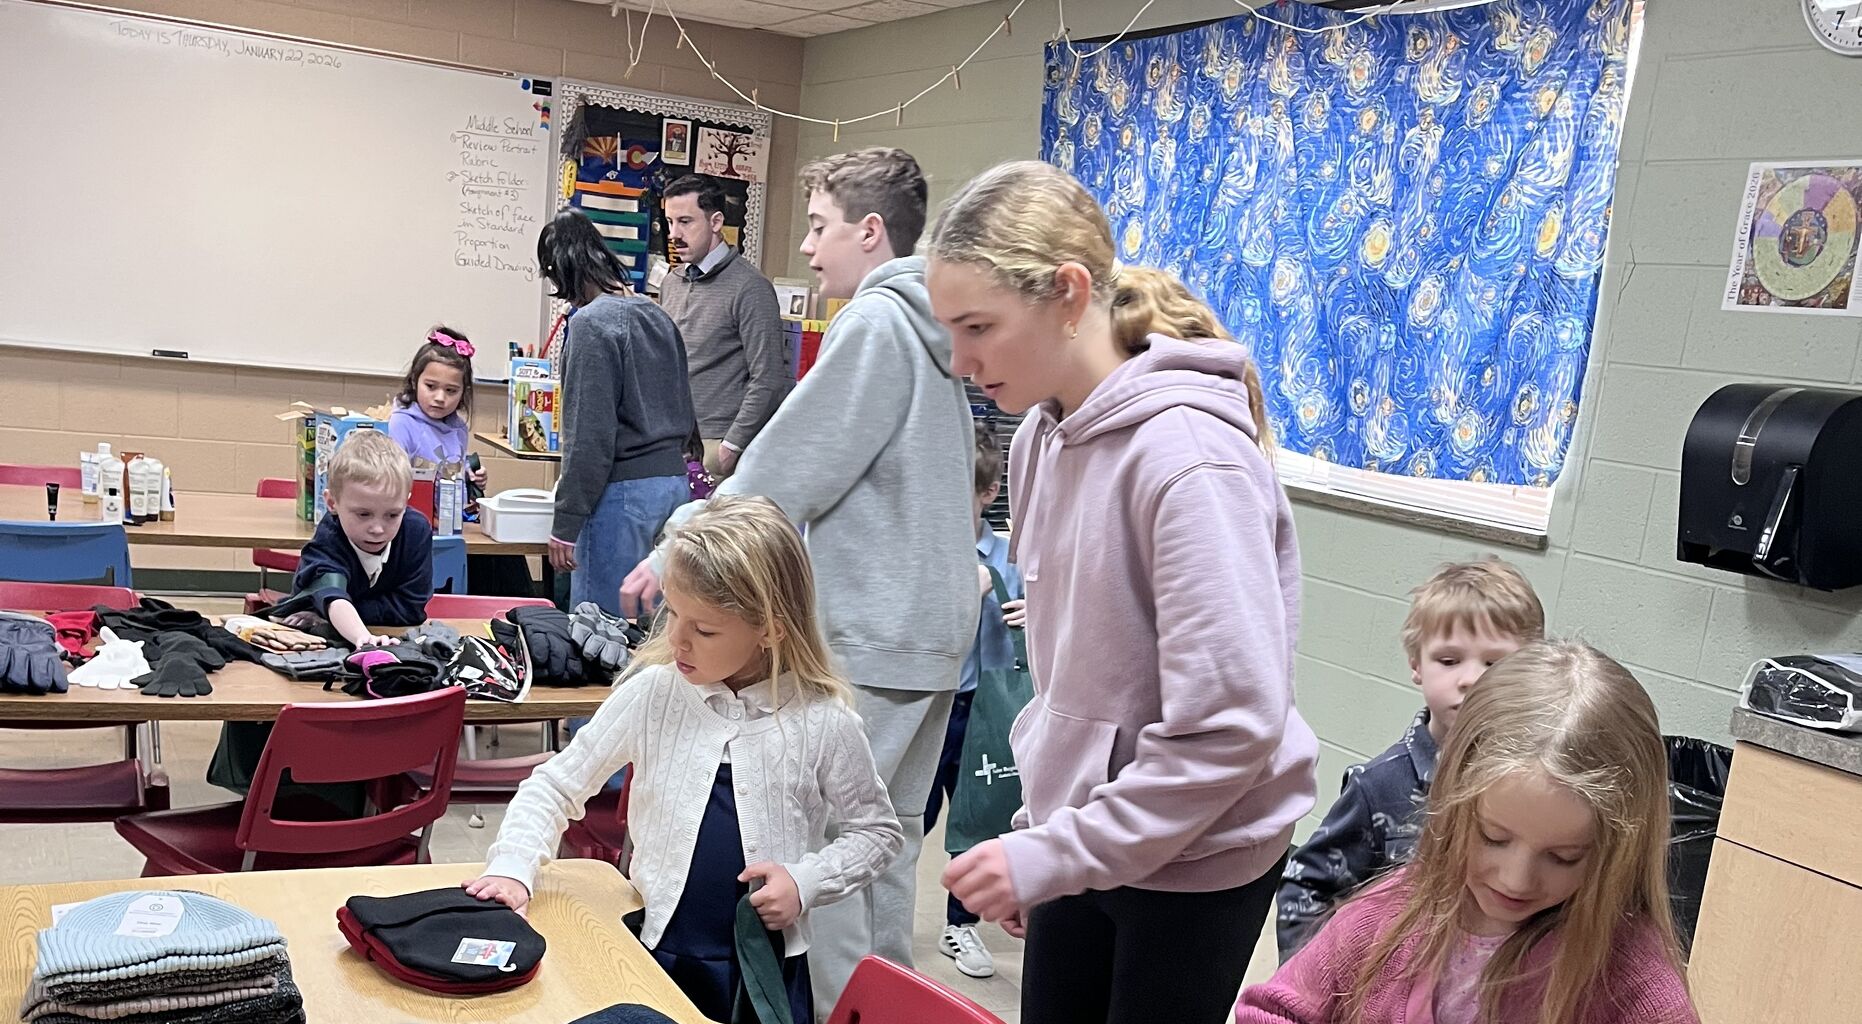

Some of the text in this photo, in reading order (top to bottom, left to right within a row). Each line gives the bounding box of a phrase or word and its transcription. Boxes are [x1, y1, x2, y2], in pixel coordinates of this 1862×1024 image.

[157, 31, 171, 45] IS
[235, 39, 284, 61] JANUARY
[285, 48, 305, 67] 22,
[307, 52, 342, 69] 2026
[465, 114, 535, 136] Middle School
[462, 134, 498, 151] Review
[460, 151, 499, 167] Rubric
[460, 170, 493, 184] Sketch
[460, 202, 493, 216] Sketch
[495, 204, 509, 220] of
[1740, 200, 1754, 236] Grace
[476, 217, 524, 235] Standard
[454, 230, 510, 251] Proportion
[1738, 239, 1746, 251] of
[1732, 254, 1745, 278] Year
[1727, 279, 1737, 301] The
